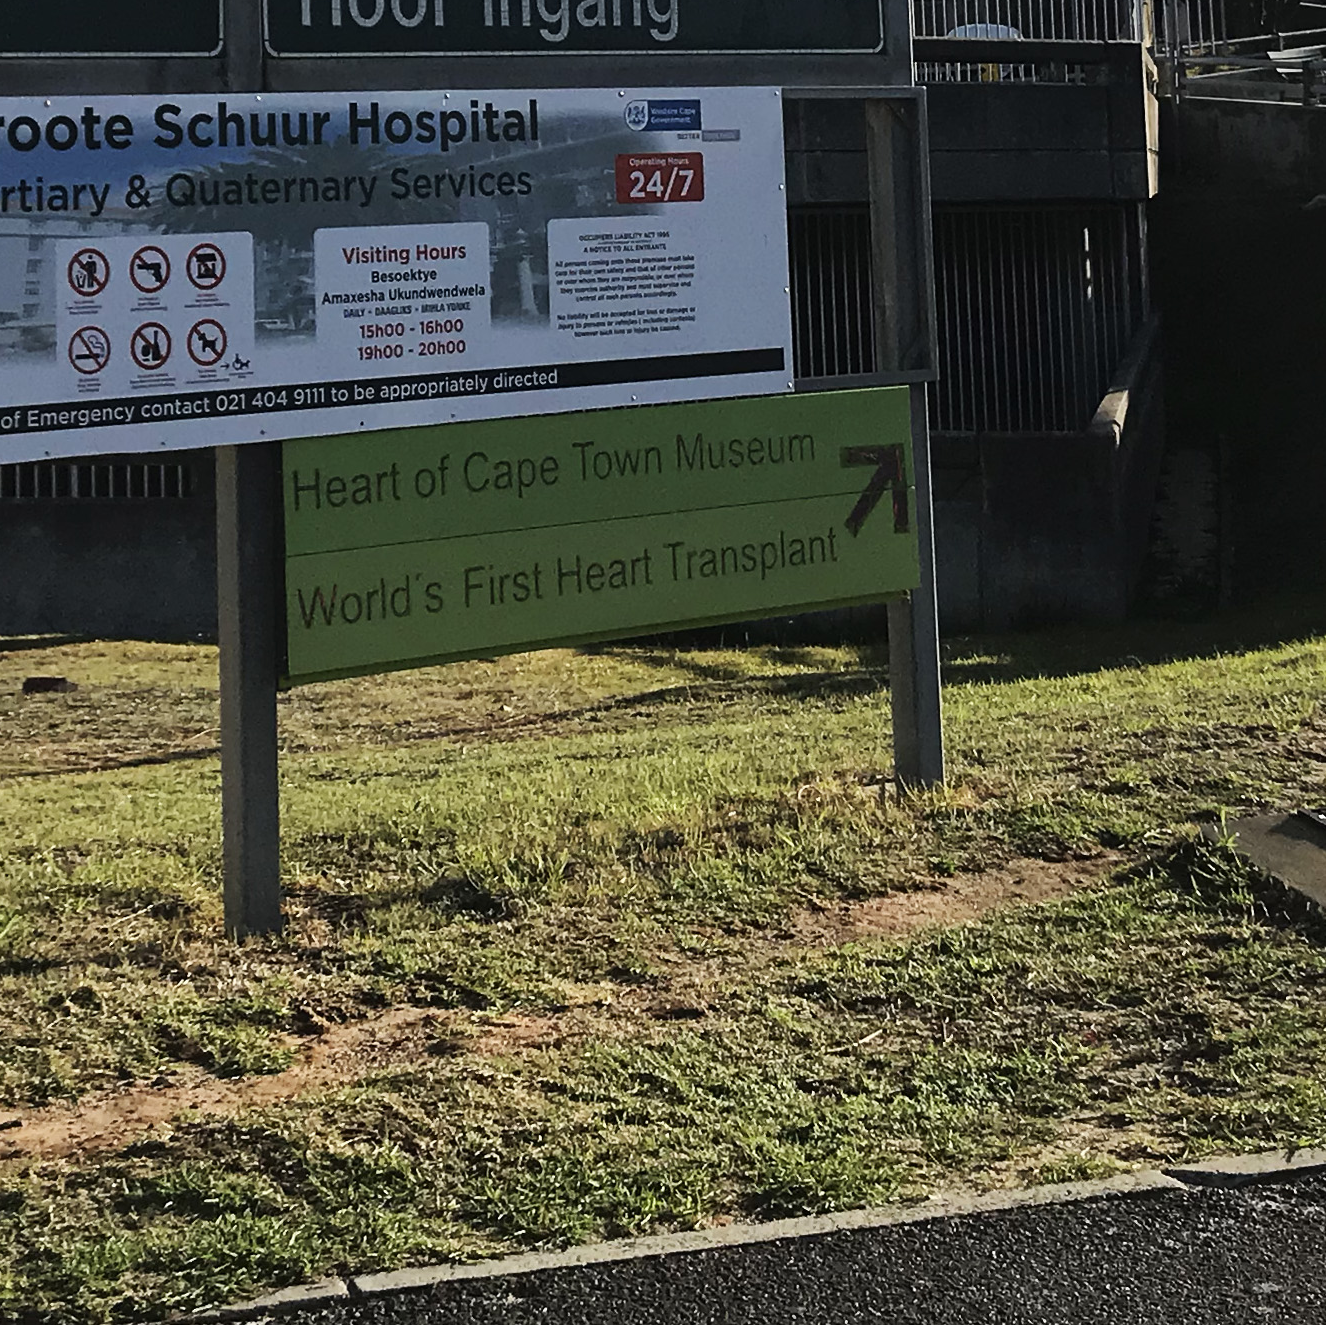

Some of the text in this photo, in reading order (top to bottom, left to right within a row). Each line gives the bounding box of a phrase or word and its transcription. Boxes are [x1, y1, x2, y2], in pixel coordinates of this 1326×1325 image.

[650, 116, 692, 124] Government
[679, 107, 696, 116] Cape
[154, 102, 331, 148] Schuur
[349, 99, 539, 151] Hospital
[629, 157, 689, 167] Operating Hours
[125, 175, 150, 208] &
[165, 170, 376, 208] Quaternary
[391, 165, 533, 201] Services
[629, 167, 694, 201] 24/7
[342, 244, 466, 265] Visiting Hours
[372, 269, 437, 283] Besoektye
[322, 284, 486, 305] Amaxesha Ukundwendwela
[343, 308, 365, 318] DAILY
[359, 322, 405, 339] 15h00
[419, 319, 464, 334] 16h00
[357, 344, 403, 360] 19h00
[418, 340, 466, 356] 20h00
[1, 410, 21, 431] of
[27, 403, 135, 428] Emergency
[141, 397, 210, 416] contact
[216, 393, 246, 411] 021
[251, 392, 288, 410] 404
[294, 389, 326, 406] 9111
[331, 387, 348, 403] to
[351, 383, 375, 401] be
[380, 375, 490, 397] appropriately
[496, 369, 558, 388] directed
[292, 431, 815, 512] Heart of Cape Town Museum
[464, 562, 543, 609] First
[557, 548, 651, 597] Heart
[665, 527, 839, 583] Transplant
